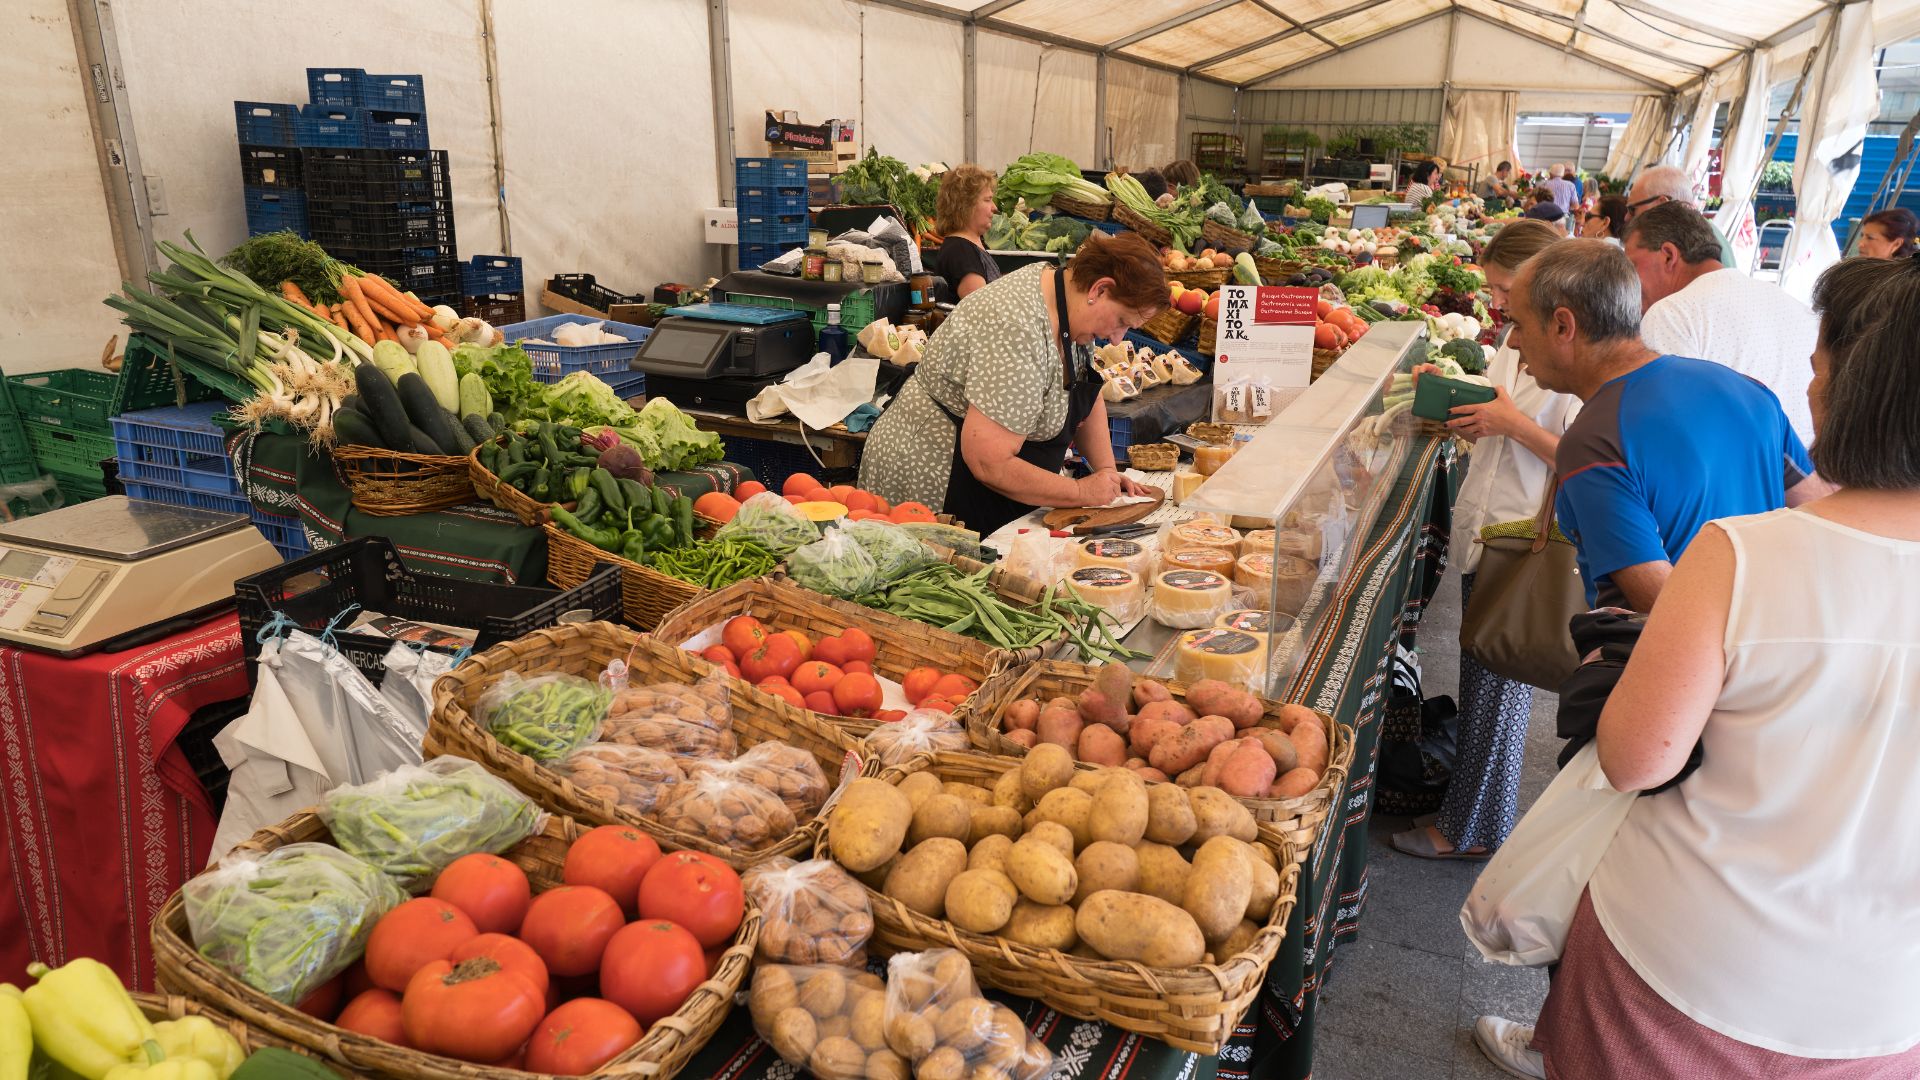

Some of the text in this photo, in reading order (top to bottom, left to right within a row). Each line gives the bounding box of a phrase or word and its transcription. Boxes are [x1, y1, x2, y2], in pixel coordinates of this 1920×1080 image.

[1228, 289, 1245, 299] TO
[1227, 300, 1248, 309] MA
[1225, 320, 1242, 329] TO
